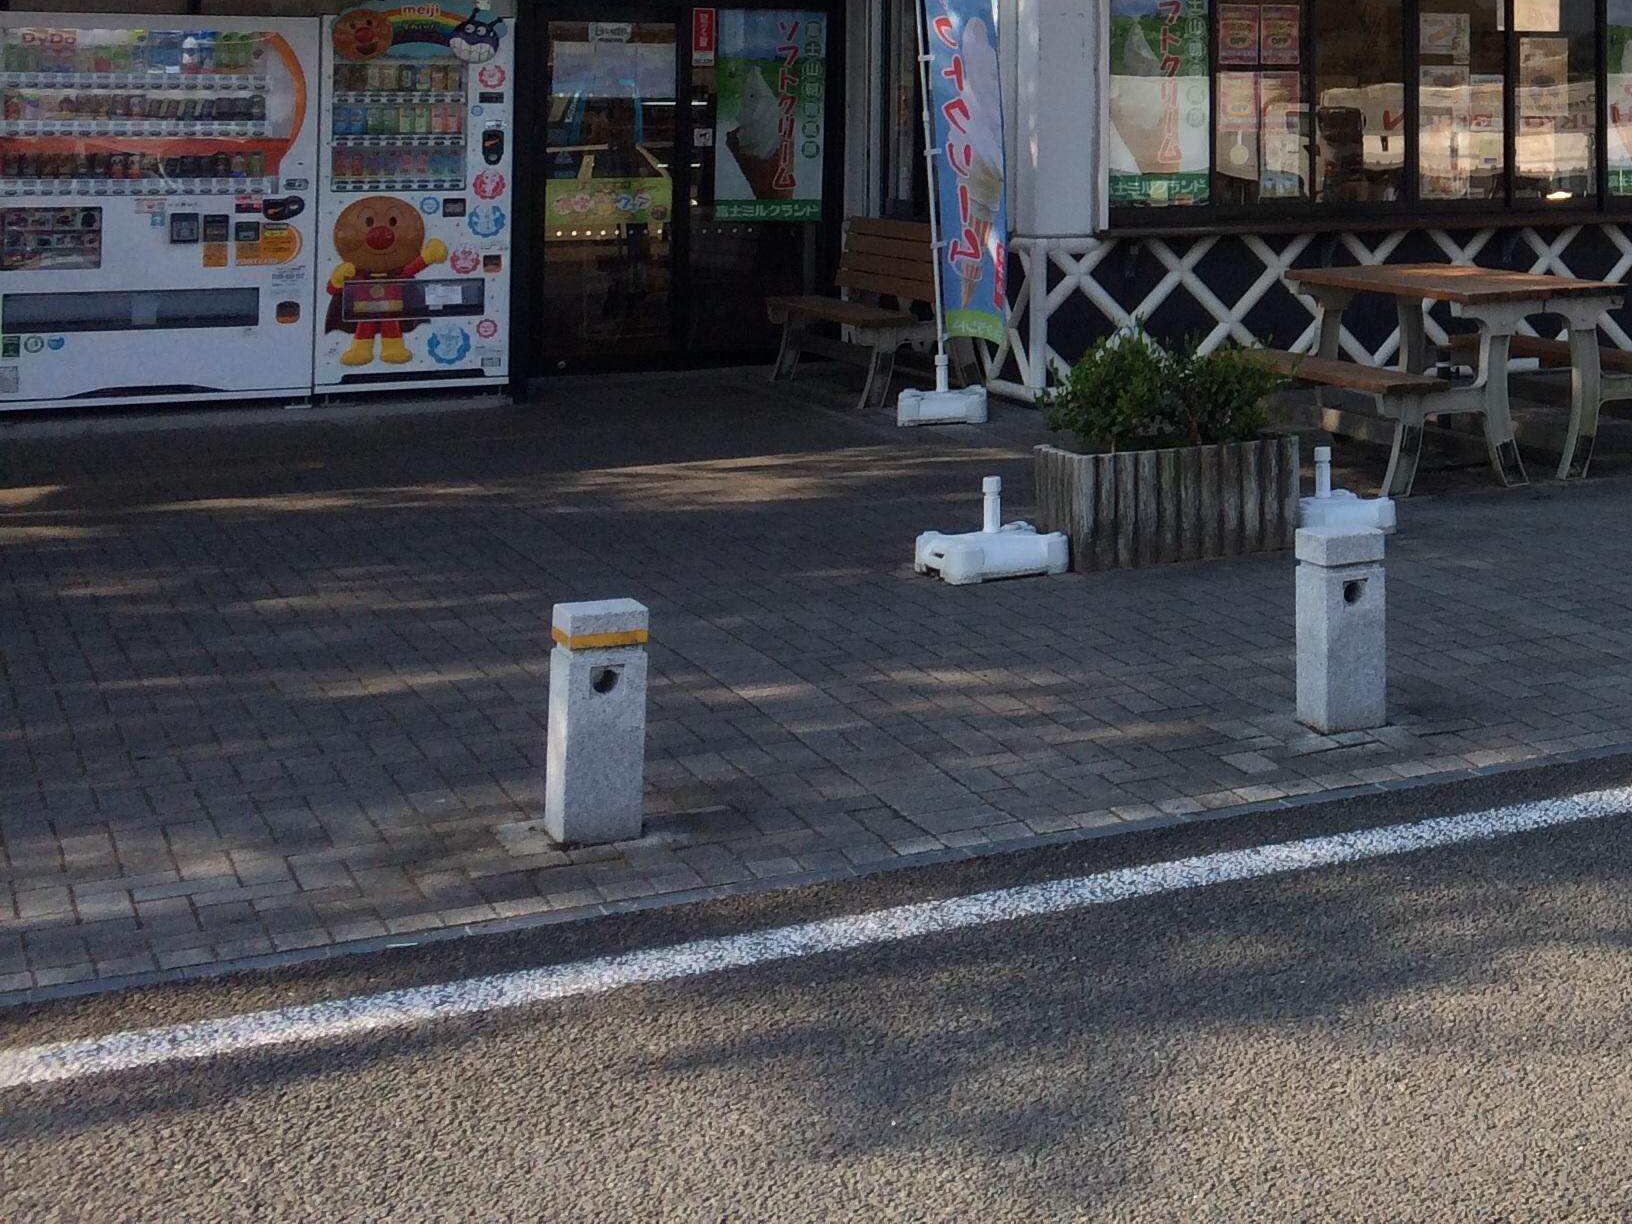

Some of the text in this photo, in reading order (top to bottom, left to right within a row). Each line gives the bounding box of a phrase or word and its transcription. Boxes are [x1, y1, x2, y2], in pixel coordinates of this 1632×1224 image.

[401, 3, 441, 18] meiji
[1271, 37, 1289, 47] OFF
[772, 20, 799, 191] ソフトクリーム
[715, 202, 820, 219] 富士ミルクランド
